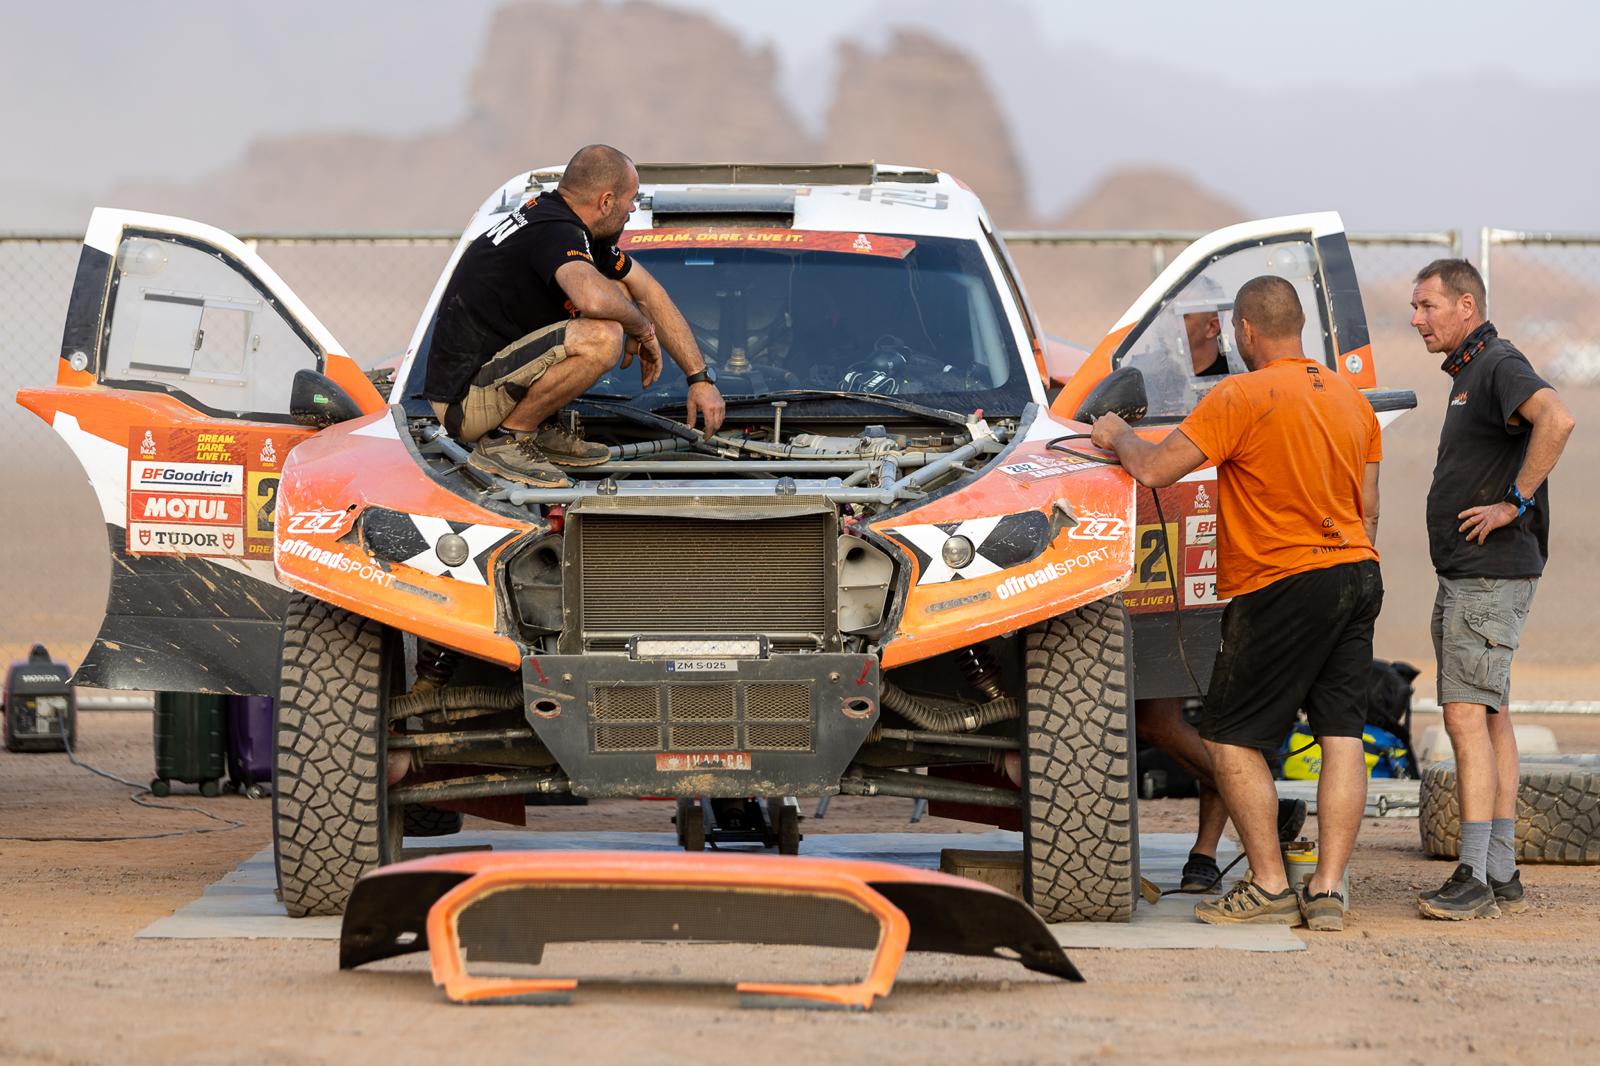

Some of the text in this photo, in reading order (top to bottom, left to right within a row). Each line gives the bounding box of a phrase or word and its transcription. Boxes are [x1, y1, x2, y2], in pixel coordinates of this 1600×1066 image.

[630, 233, 804, 243] DREAM. DARE. LIVE IT.
[197, 433, 237, 444] DREAM.
[196, 443, 227, 452] DARE.
[196, 452, 232, 461] LIVE IT.
[141, 468, 233, 483] BFGoodrich
[144, 497, 229, 520] MOTUL
[155, 531, 219, 547] TUDOR
[1134, 529, 1167, 584] 2
[1141, 595, 1165, 606] LIVE
[677, 661, 693, 670] ZM
